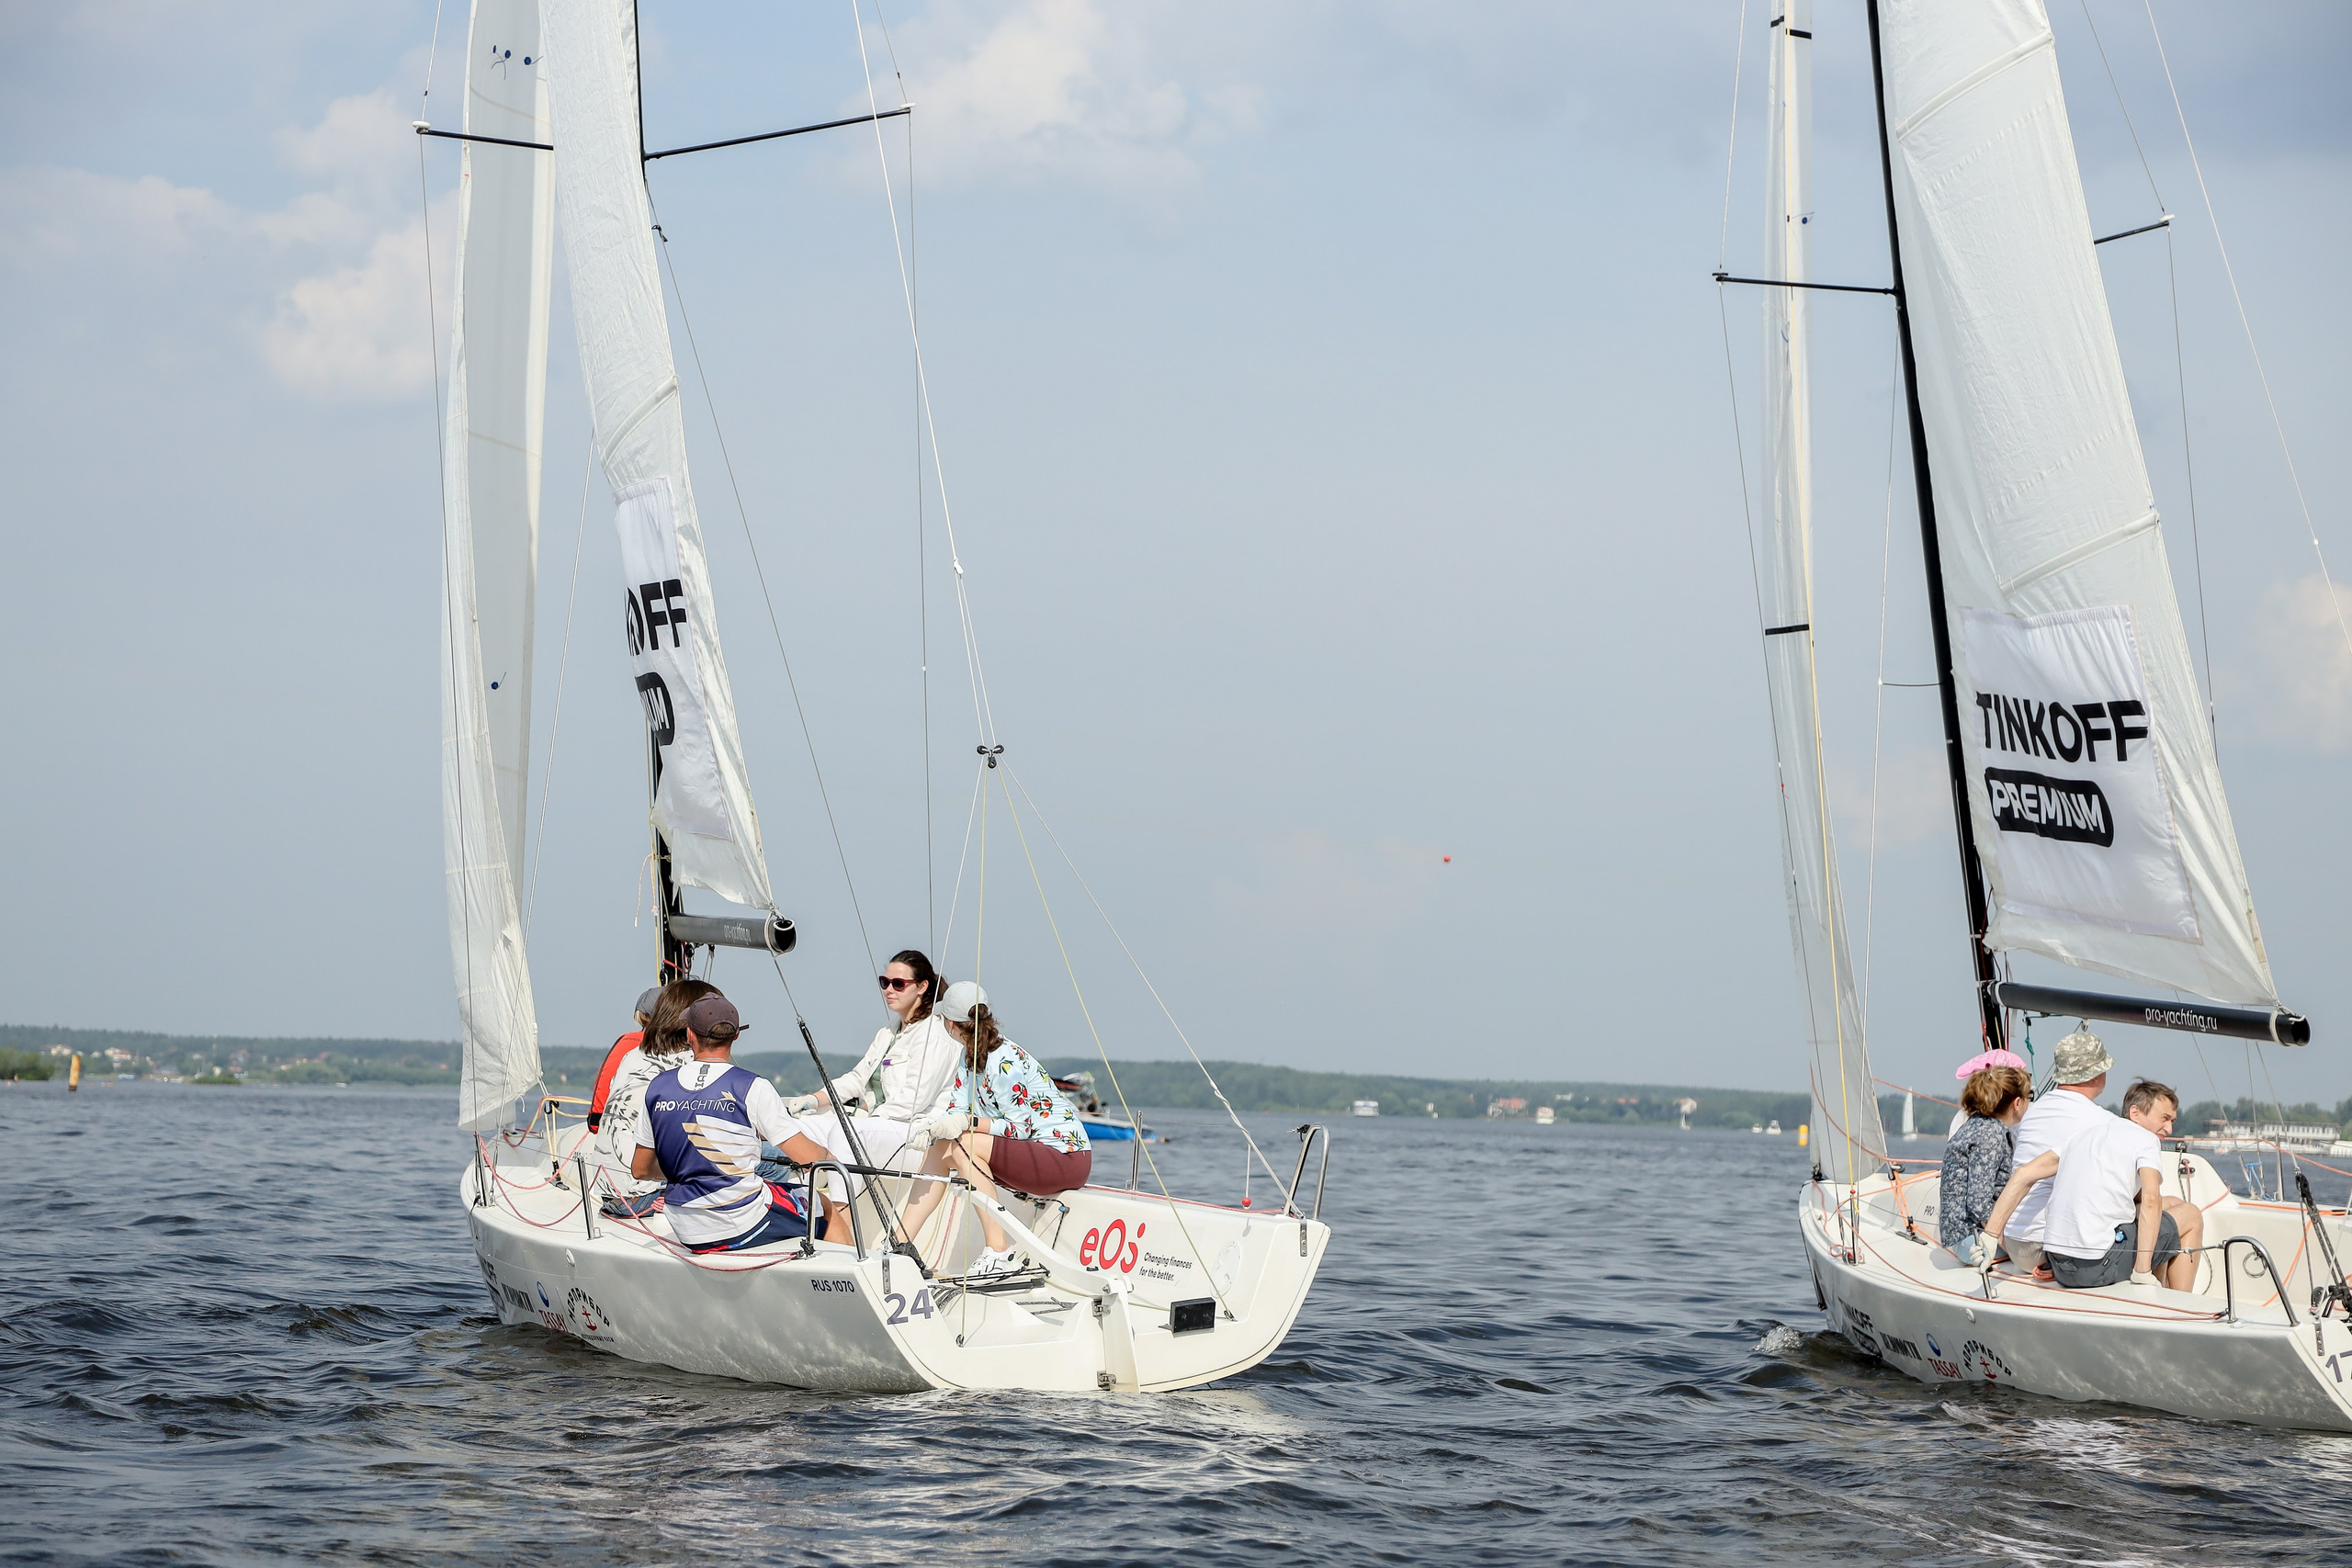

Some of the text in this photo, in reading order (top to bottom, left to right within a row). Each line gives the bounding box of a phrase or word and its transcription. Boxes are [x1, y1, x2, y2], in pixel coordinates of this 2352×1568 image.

[624, 579, 687, 657] OFF
[1975, 690, 2149, 763] TINKOFF
[1988, 779, 2107, 834] PREMIUM
[2144, 1008, 2218, 1032] pro-yachting.ru
[654, 1100, 735, 1113] PROYACHTING
[1144, 1252, 1193, 1269] Changing finances
[1139, 1267, 1175, 1281] for the better.
[810, 1279, 855, 1293] RUS 1070
[884, 1289, 934, 1325] 24
[1928, 1358, 1963, 1379] TASSAY
